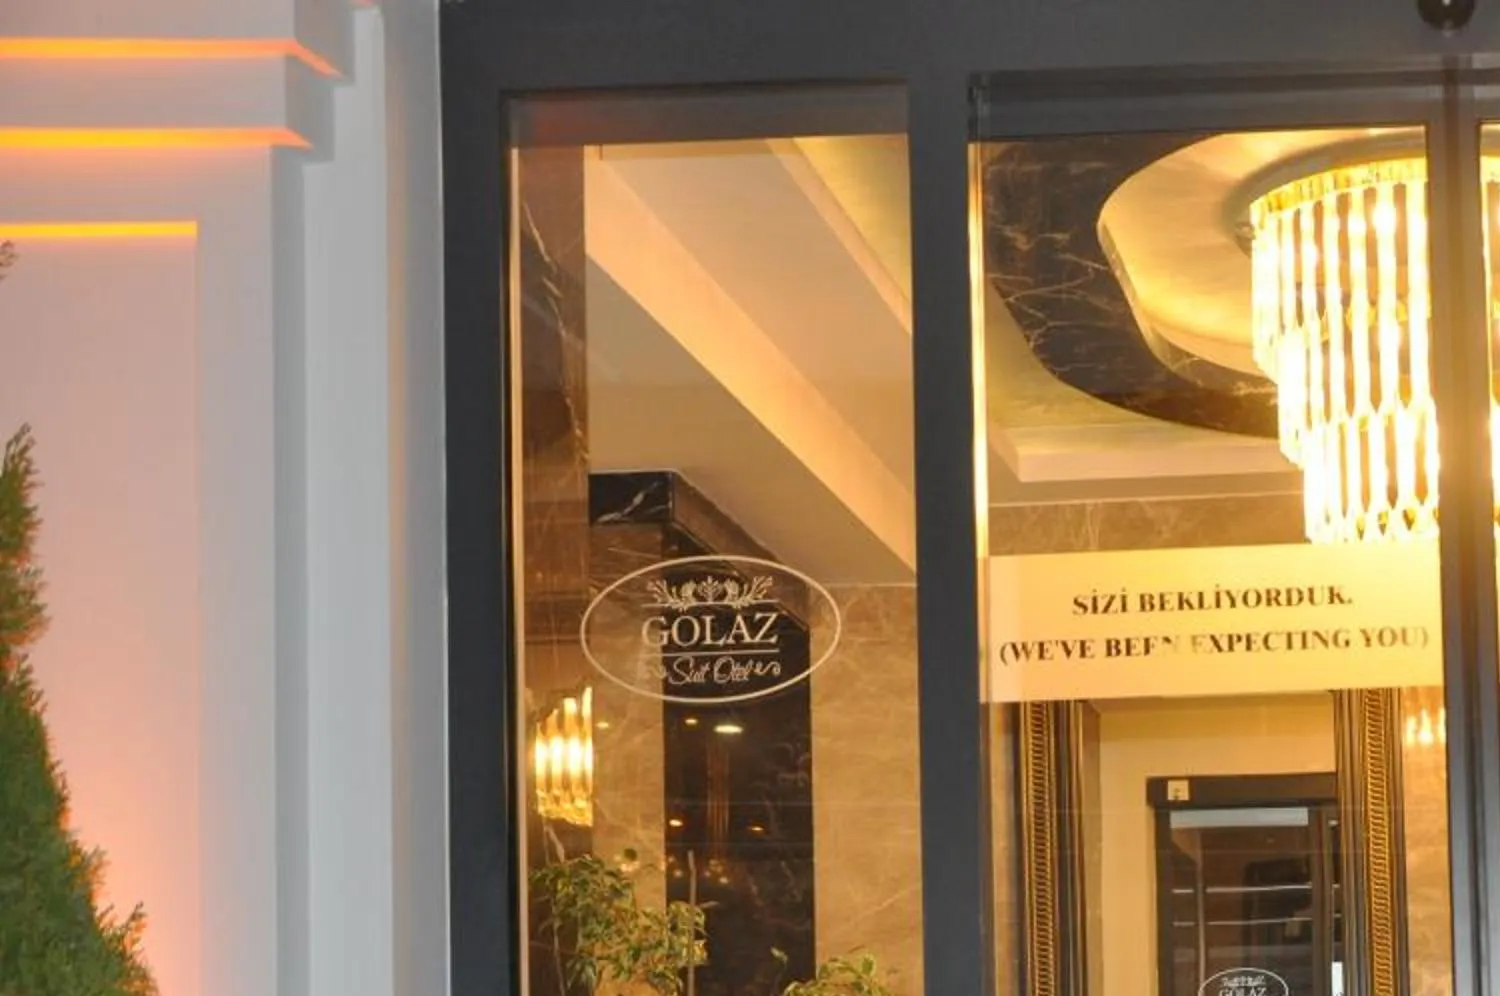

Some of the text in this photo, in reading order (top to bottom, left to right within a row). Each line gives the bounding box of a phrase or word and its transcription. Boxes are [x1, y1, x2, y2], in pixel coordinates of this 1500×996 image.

[1072, 583, 1353, 616] SİZİ BEKLİYORDUK.
[641, 611, 779, 648] GOLAZ
[999, 638, 1095, 666] (WE'VE
[1190, 630, 1351, 655] EXPECTING
[1359, 626, 1429, 650] YOU)
